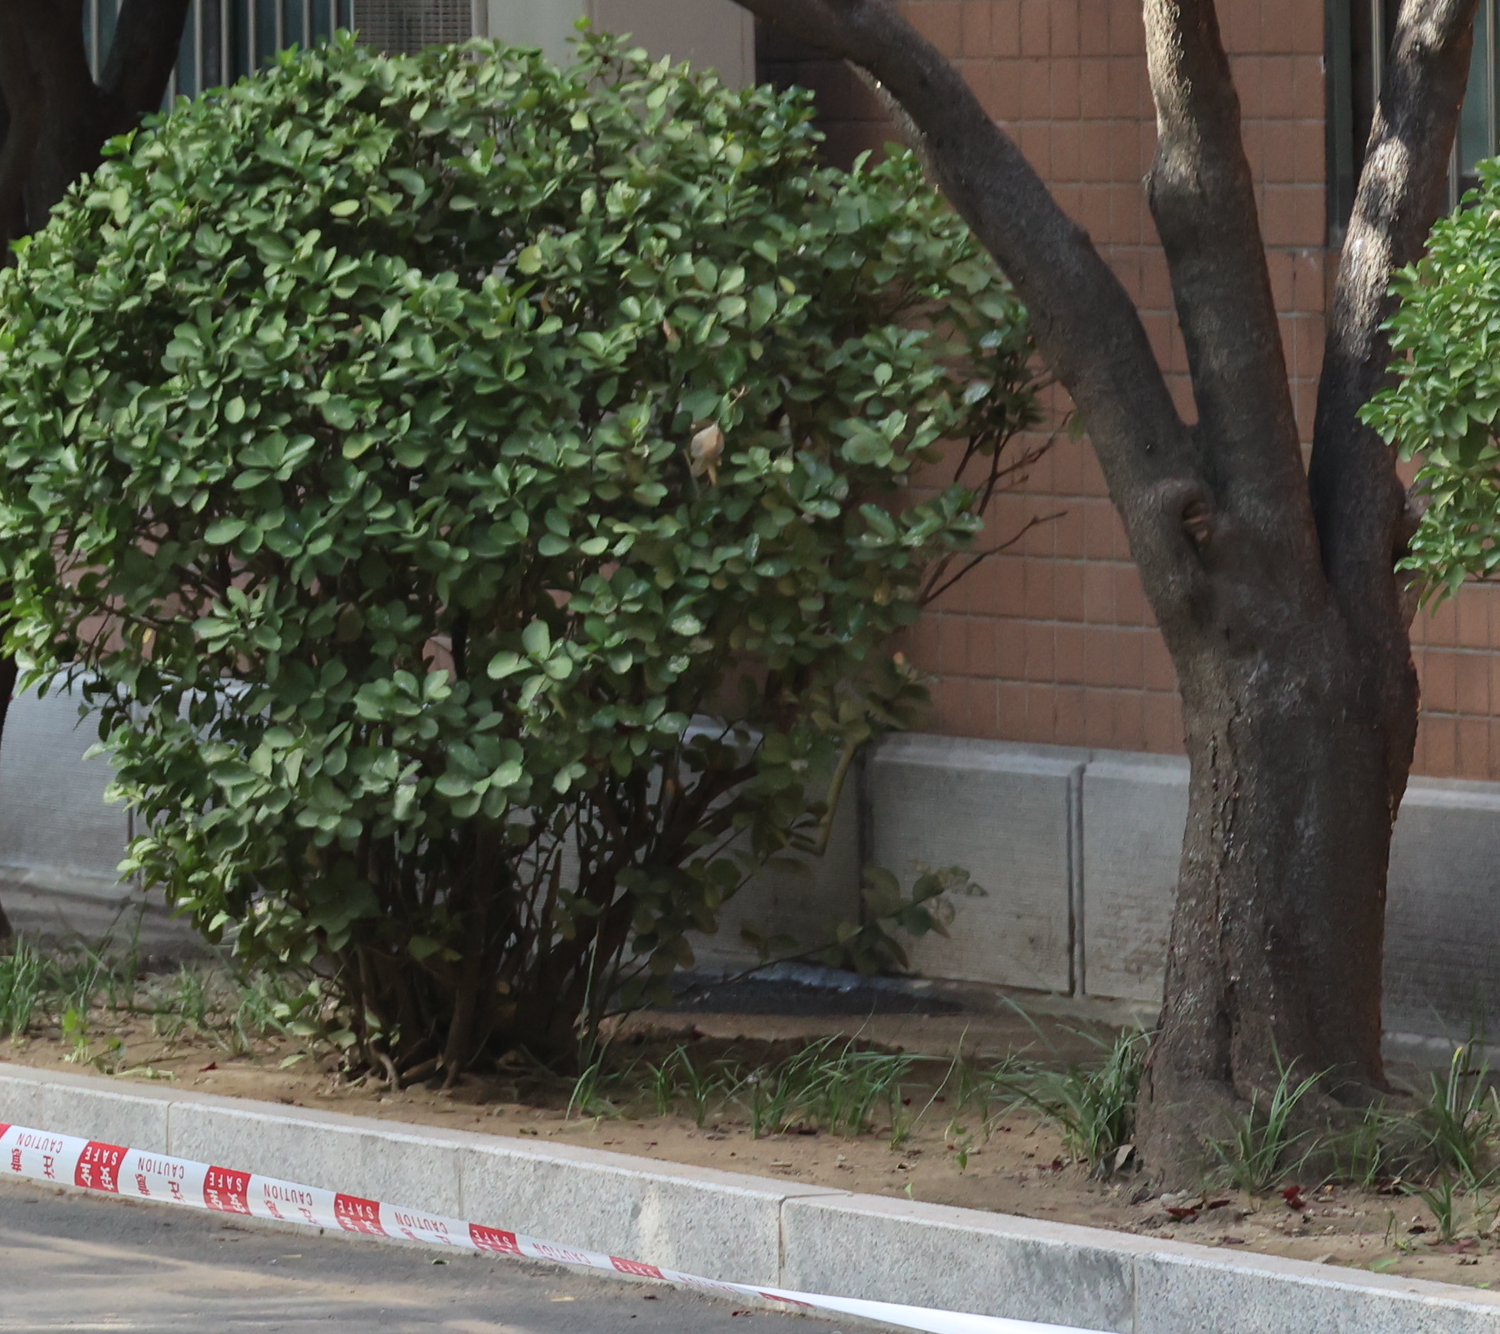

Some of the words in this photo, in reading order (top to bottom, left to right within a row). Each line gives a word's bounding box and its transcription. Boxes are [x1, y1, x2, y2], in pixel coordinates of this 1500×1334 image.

[10, 1148, 56, 1179] 注意
[80, 1162, 116, 1191] 安全
[135, 1173, 186, 1204] 注意
[206, 1188, 248, 1214] 安全
[16, 1132, 64, 1154] CAUTION
[84, 1146, 119, 1166] SAFE
[137, 1156, 185, 1180] CAUTION
[209, 1171, 243, 1192] SAFE
[263, 1183, 313, 1207] CAUTION
[337, 1199, 375, 1220] SAFE
[395, 1211, 449, 1235] CAUTION
[472, 1228, 513, 1249] SAFE
